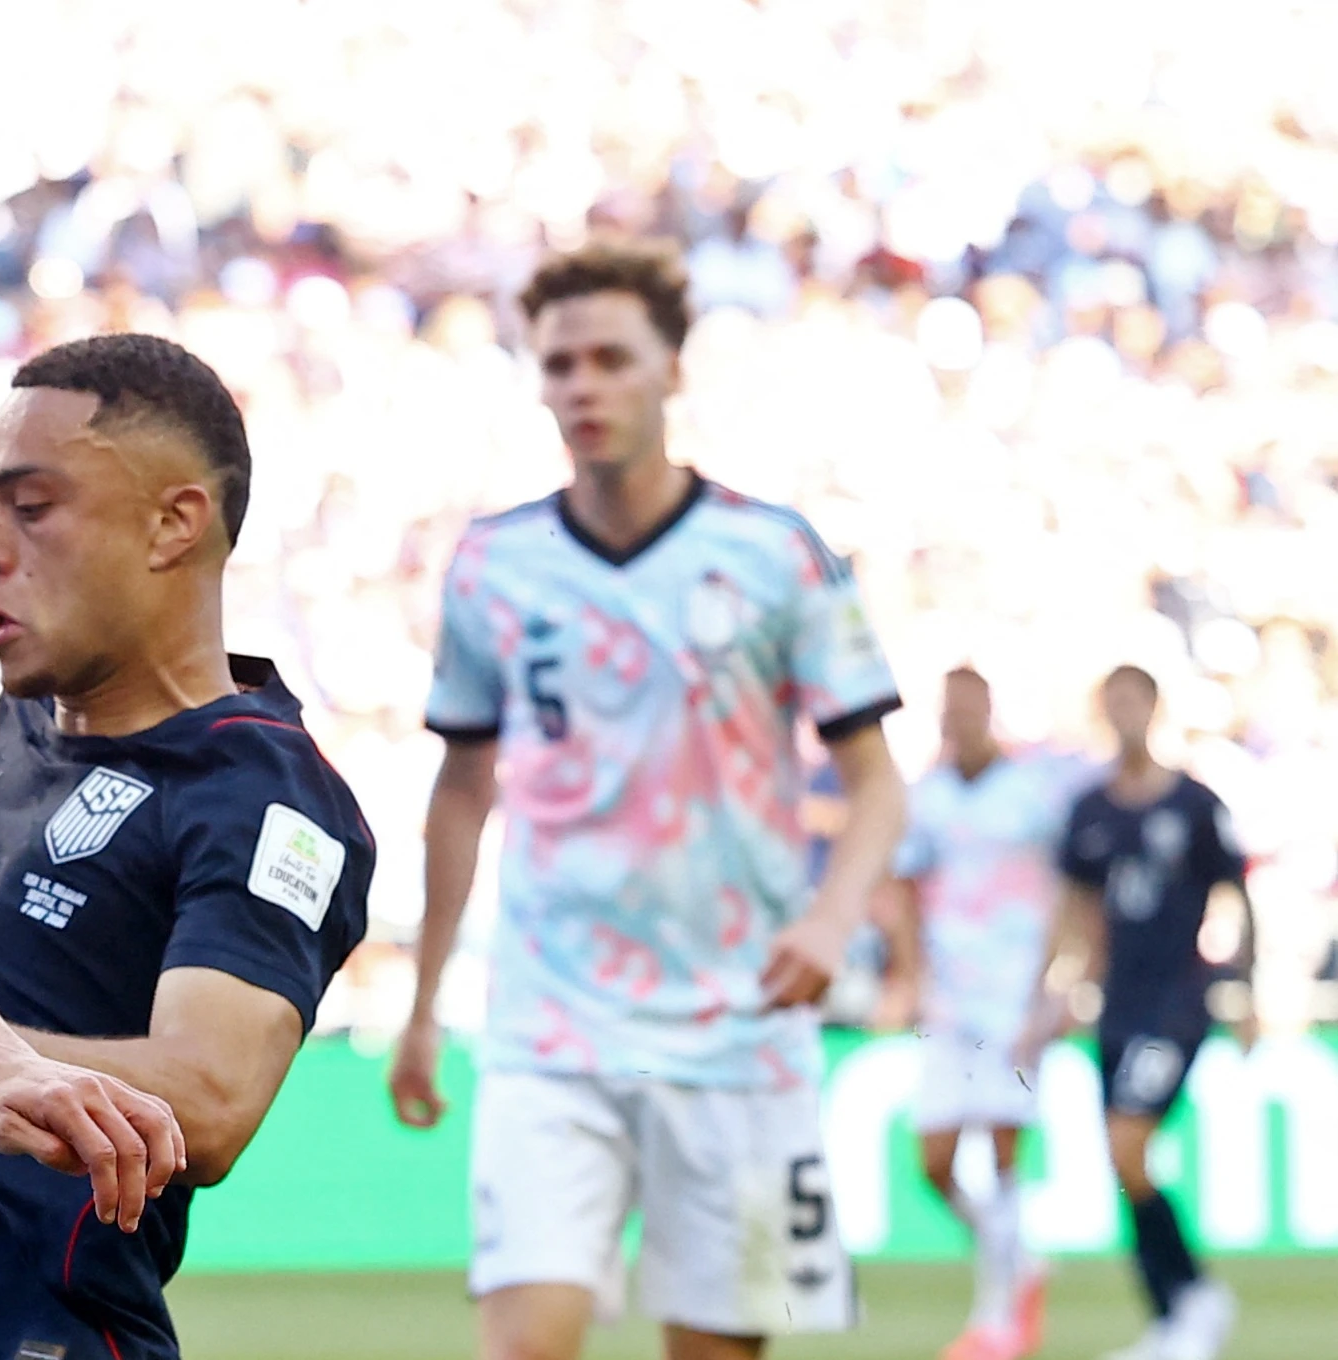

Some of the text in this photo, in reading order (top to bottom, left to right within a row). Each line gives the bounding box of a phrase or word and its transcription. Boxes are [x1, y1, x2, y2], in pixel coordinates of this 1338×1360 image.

[527, 657, 568, 741] 5
[82, 773, 143, 812] USA
[788, 1154, 825, 1243] 5
